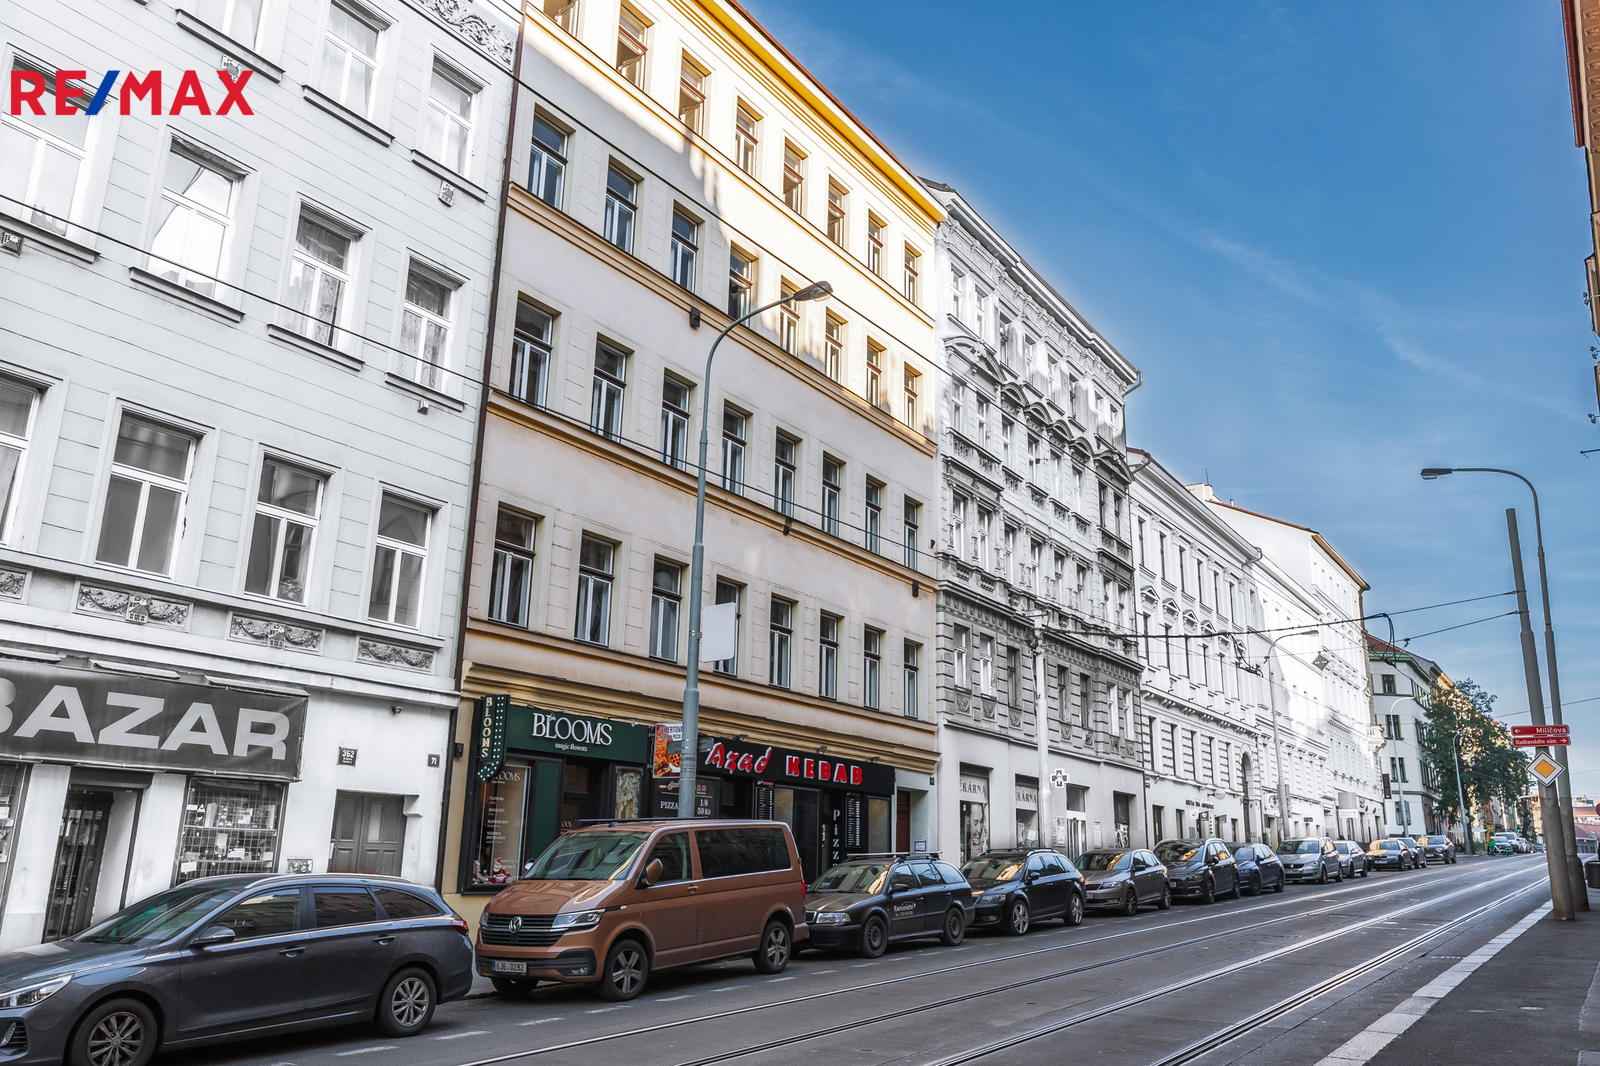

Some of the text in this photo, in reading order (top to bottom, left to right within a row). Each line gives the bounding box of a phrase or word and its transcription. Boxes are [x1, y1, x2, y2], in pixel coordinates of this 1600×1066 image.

[481, 697, 493, 758] BLOOMS
[532, 712, 612, 746] BLOOMS
[493, 771, 521, 781] OOMS
[705, 742, 863, 785] Azad KEBAB
[660, 801, 679, 809] PIZZA
[832, 809, 841, 867] Pizz
